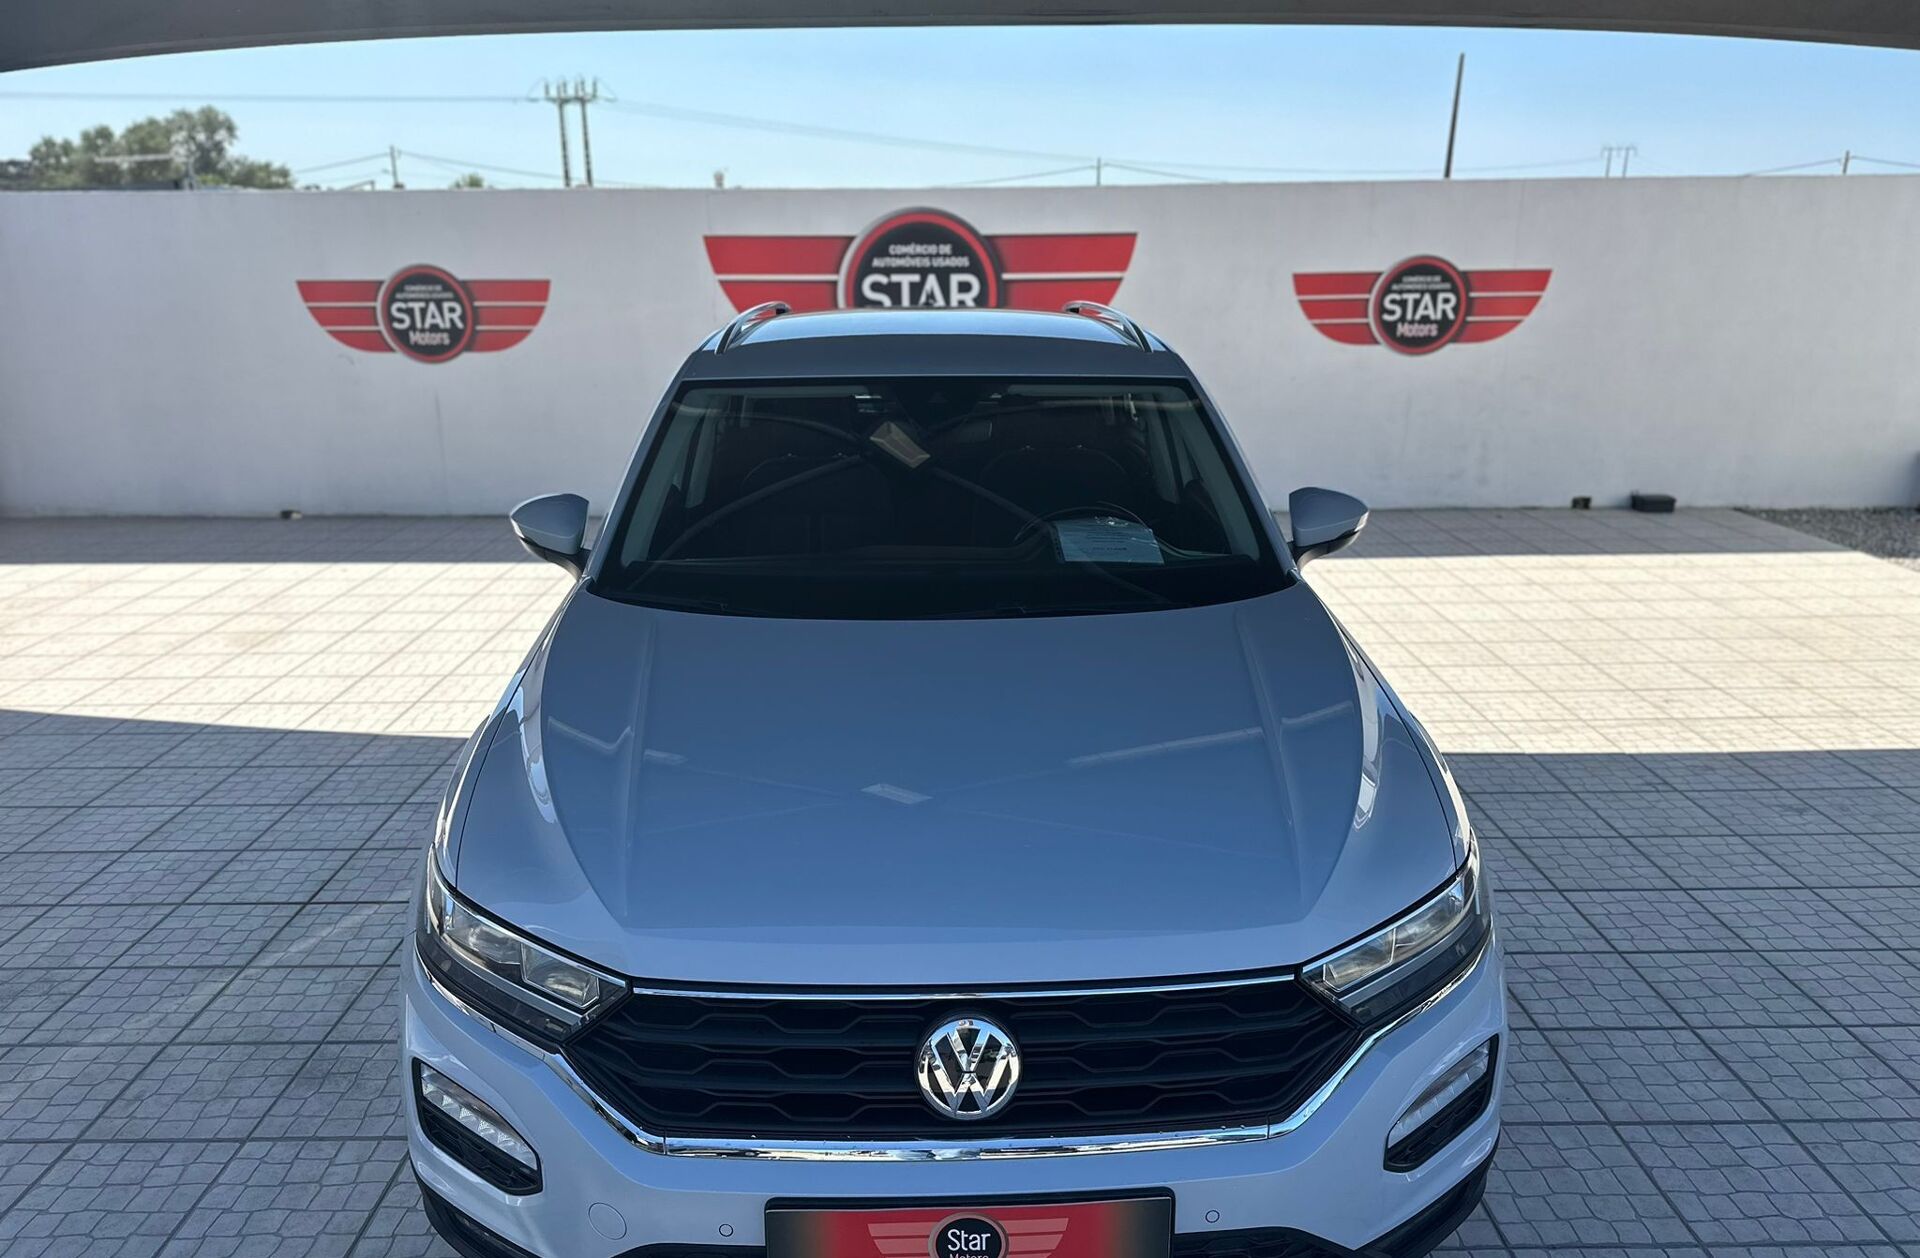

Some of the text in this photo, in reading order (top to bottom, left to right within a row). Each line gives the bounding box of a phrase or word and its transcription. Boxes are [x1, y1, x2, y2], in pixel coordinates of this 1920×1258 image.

[888, 242, 952, 255] COMÉRCIO DE
[872, 255, 970, 268] AUTOMÓVEIS USADOS
[861, 273, 981, 307] STAR
[391, 301, 464, 330] STAR
[1382, 291, 1457, 321] STAR
[409, 330, 450, 346] Motors
[1396, 321, 1438, 337] Motors
[947, 1229, 991, 1251] Star
